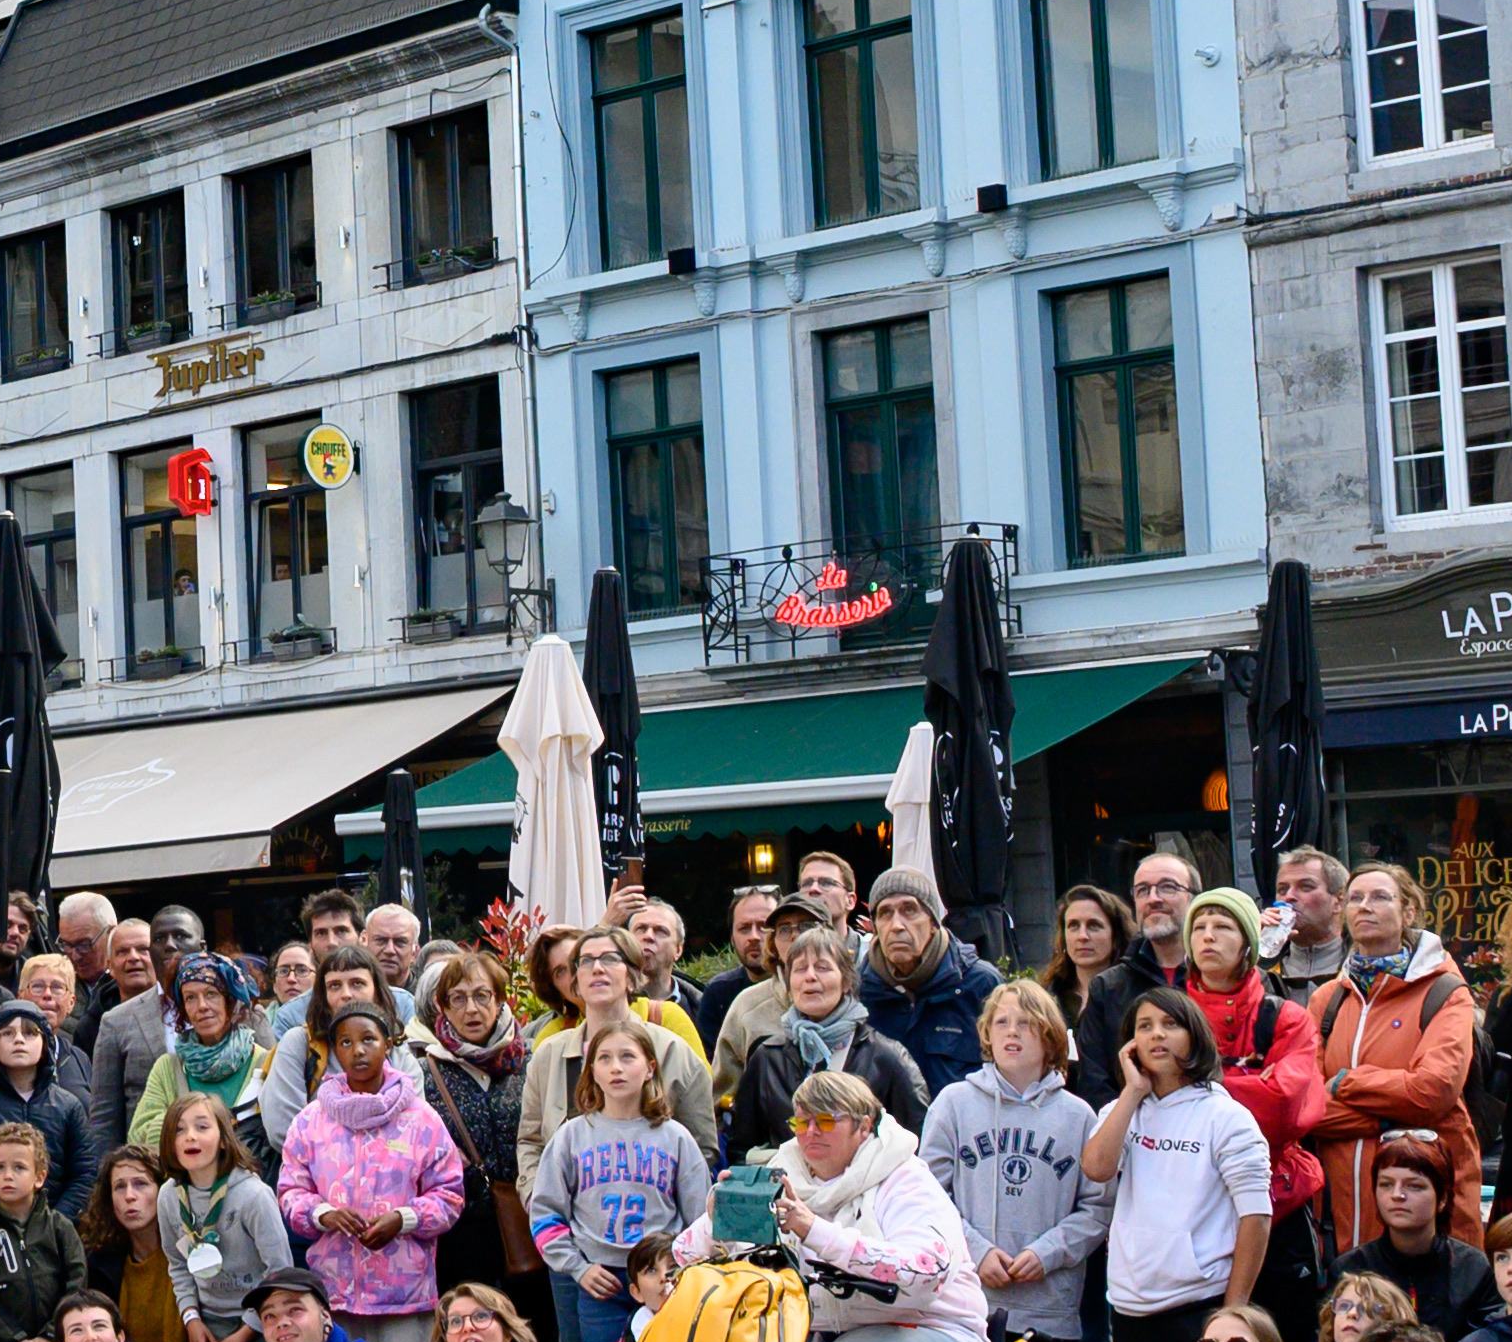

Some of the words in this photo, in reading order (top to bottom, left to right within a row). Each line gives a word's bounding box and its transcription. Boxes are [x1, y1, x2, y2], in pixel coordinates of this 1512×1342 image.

[154, 342, 265, 397] Jupiler
[311, 441, 347, 458] CHOUFFE
[815, 562, 847, 590] La
[775, 582, 892, 627] Brasserie
[1441, 607, 1487, 638] LA
[1460, 714, 1488, 734] LA
[644, 817, 692, 833] rasserie
[1453, 841, 1495, 859] AUX
[1463, 891, 1488, 909] LA
[959, 1127, 1076, 1181] SEVILLA
[575, 1140, 678, 1197] REAME
[1005, 1186, 1024, 1197] SEV
[600, 1193, 647, 1244] 72
